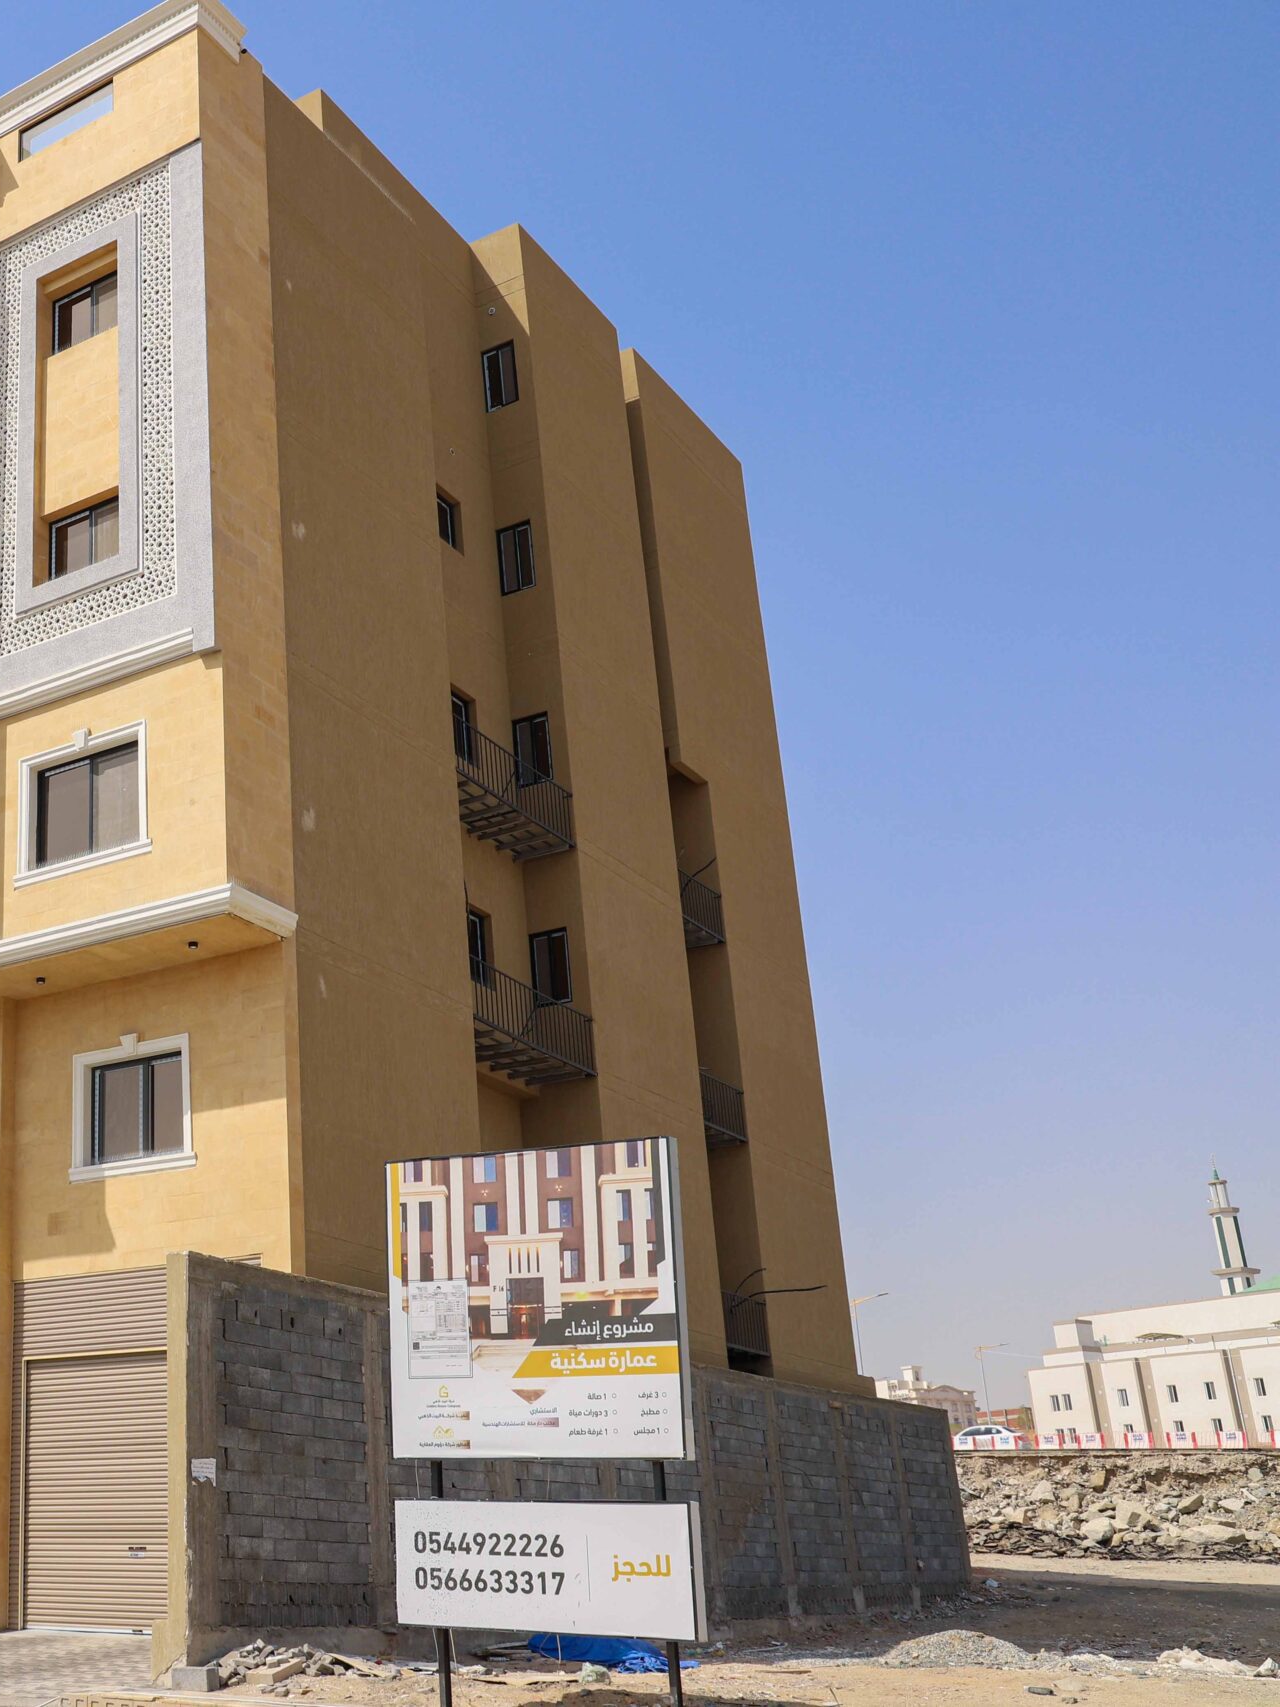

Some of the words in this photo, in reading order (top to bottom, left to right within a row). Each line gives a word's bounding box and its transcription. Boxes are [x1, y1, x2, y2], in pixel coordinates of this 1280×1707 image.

[564, 1320, 601, 1340] إنشاء
[603, 1317, 654, 1338] مشروع
[550, 1352, 606, 1374] سكنية
[608, 1350, 657, 1372] عمارة
[638, 1392, 653, 1400] غرف
[654, 1391, 659, 1399] 3
[583, 1409, 603, 1418] دورات
[640, 1407, 661, 1417] مطبخ
[568, 1428, 586, 1437] طعام
[587, 1428, 603, 1437] غرفة
[633, 1426, 656, 1436] مجلس
[413, 1531, 564, 1558] 0544922226
[611, 1554, 671, 1582] للحجز
[415, 1566, 565, 1595] 0566633317
